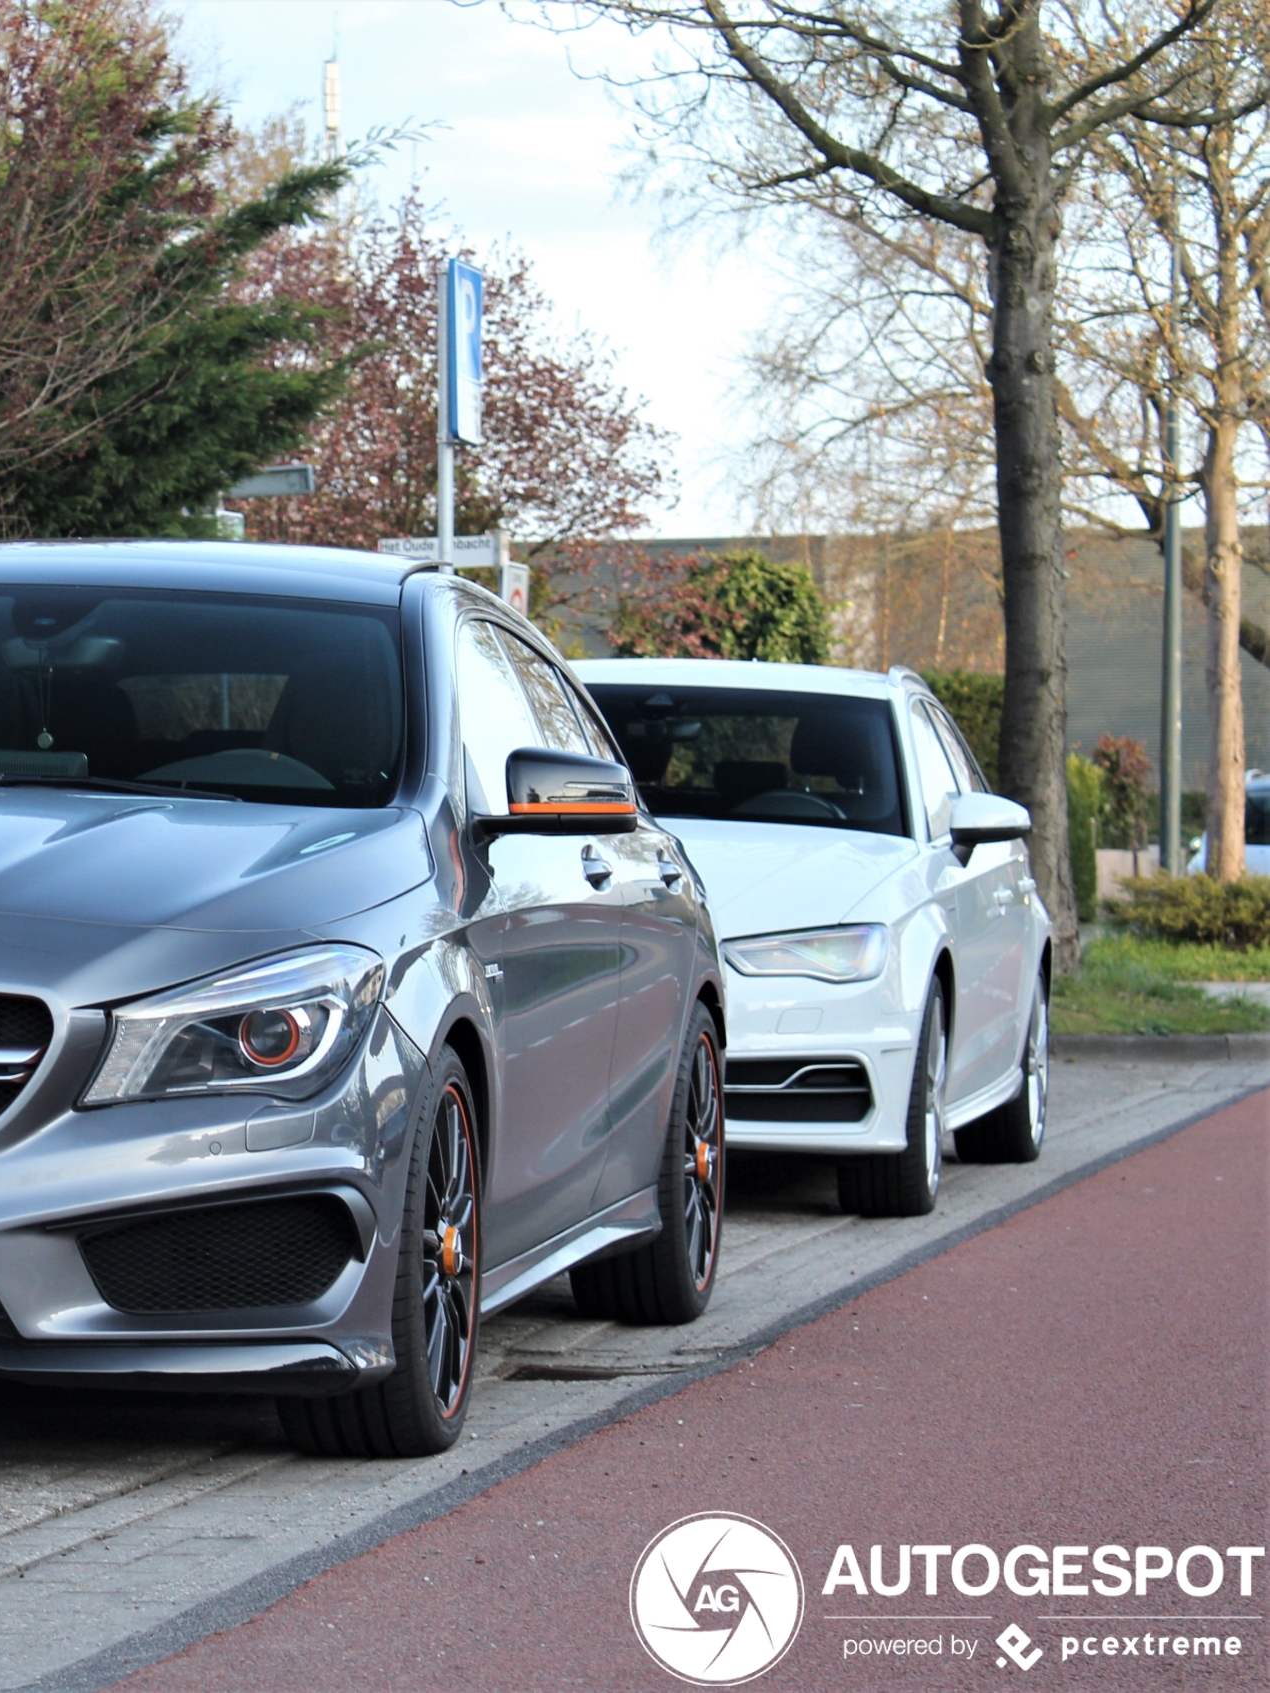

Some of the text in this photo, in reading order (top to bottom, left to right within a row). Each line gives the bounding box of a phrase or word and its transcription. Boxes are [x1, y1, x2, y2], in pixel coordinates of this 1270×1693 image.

[460, 278, 476, 364] P
[381, 541, 400, 552] Het
[403, 540, 434, 551] Oude
